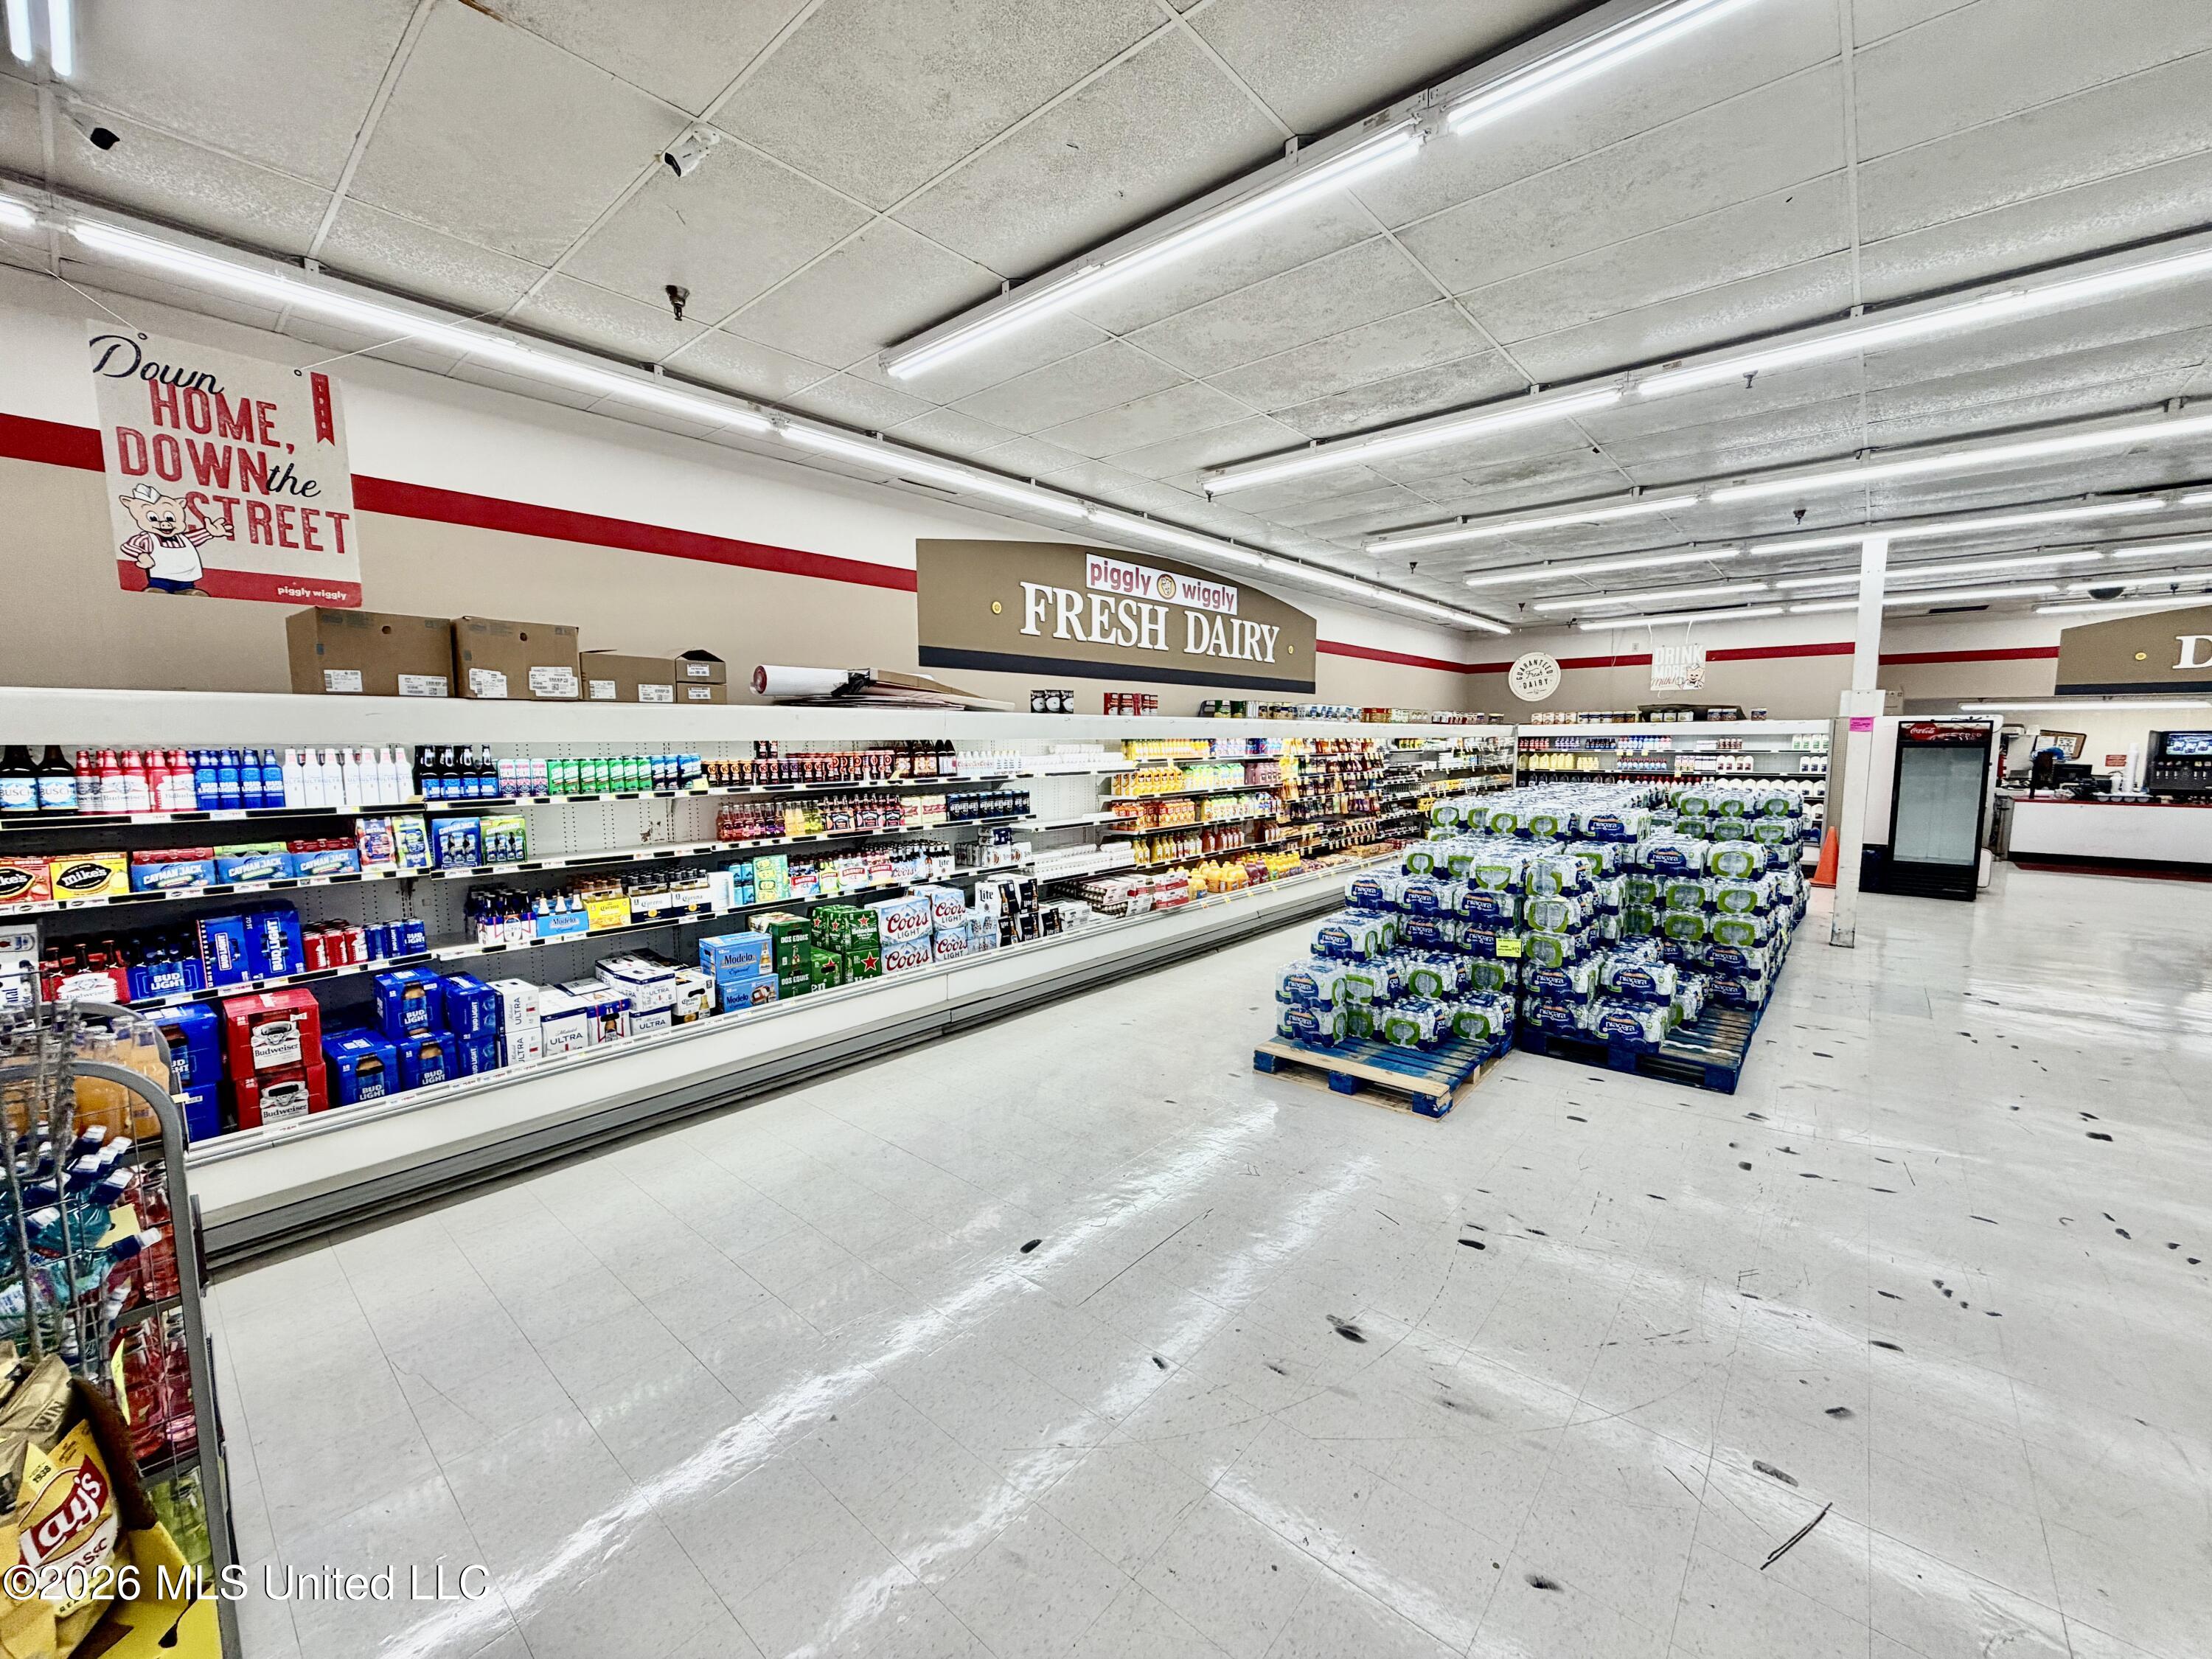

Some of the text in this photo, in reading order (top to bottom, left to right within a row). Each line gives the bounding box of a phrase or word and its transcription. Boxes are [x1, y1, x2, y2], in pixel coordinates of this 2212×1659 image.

[89, 335, 224, 394] Down
[150, 379, 294, 454] HOME,
[116, 426, 321, 498] DOWN the
[185, 491, 349, 554] STREET
[1090, 560, 1235, 611] piggly wiggly
[277, 586, 347, 600] piggly wiggly
[1020, 582, 1280, 664] FRESH DAIRY
[1655, 644, 1705, 664] DRINK
[2172, 635, 2212, 669] D
[1516, 659, 1554, 681] GUARANTEED
[1653, 665, 1688, 679] MORE
[1523, 678, 1549, 689] DAIRY
[1593, 822, 1617, 830] niagara
[300, 852, 349, 871] CAYMAN JACK
[939, 860, 950, 868] Lite
[1652, 855, 1680, 863] niagara
[229, 857, 282, 877] CAYMAN JACK
[892, 866, 916, 877] Coors
[0, 874, 28, 885] ke's
[62, 869, 107, 886] mike's
[143, 865, 203, 884] CAYMAN JACK
[979, 889, 993, 902] Lite
[1354, 886, 1376, 895] niagara
[641, 899, 663, 908] Corona
[683, 894, 703, 902] Corona
[1408, 894, 1432, 902] niagara
[934, 902, 966, 917] Coors
[1467, 900, 1492, 911] niagara
[552, 917, 577, 926] Modelo
[886, 912, 929, 933] Coors
[942, 915, 962, 923] LIGHT
[897, 928, 920, 939] LIGHT
[1409, 925, 1433, 934] niagara
[404, 936, 425, 945] LIGHT
[793, 934, 809, 942] EQUIS
[1321, 934, 1346, 945] niagara
[1469, 933, 1494, 944] niagara
[267, 920, 283, 970] BUD LIGHT
[936, 939, 967, 953] Coors
[218, 935, 229, 969] BUD LIGHT
[943, 951, 963, 960] LIGHT
[1711, 951, 1738, 961] niagara
[724, 953, 754, 965] Modelo
[885, 949, 930, 971] Coors
[154, 973, 181, 982] BUD
[793, 974, 810, 983] EQUIS
[1537, 975, 1564, 986] niagara
[1619, 975, 1647, 987] niagara
[151, 980, 185, 990] LIGHT
[1288, 981, 1312, 991] niagara
[1711, 984, 1738, 994] niagara
[649, 987, 669, 995] ULTRA
[726, 993, 748, 1005] Modelo
[405, 1015, 428, 1023] LIGHT
[406, 1009, 425, 1018] BUD
[1538, 1009, 1567, 1020] niagara
[639, 1020, 666, 1029] ULTRA
[1288, 1015, 1312, 1026] niagara
[1605, 1021, 1635, 1033] niagara
[550, 1032, 583, 1045] ULTRA
[254, 1043, 299, 1057] Budweiser
[424, 1070, 442, 1079] BUD
[422, 1076, 445, 1085] LIGHT
[362, 1085, 382, 1093] BUD
[360, 1091, 385, 1101] LIGHT
[263, 1105, 307, 1119] Budweiser
[19, 1472, 101, 1564] Lay's
